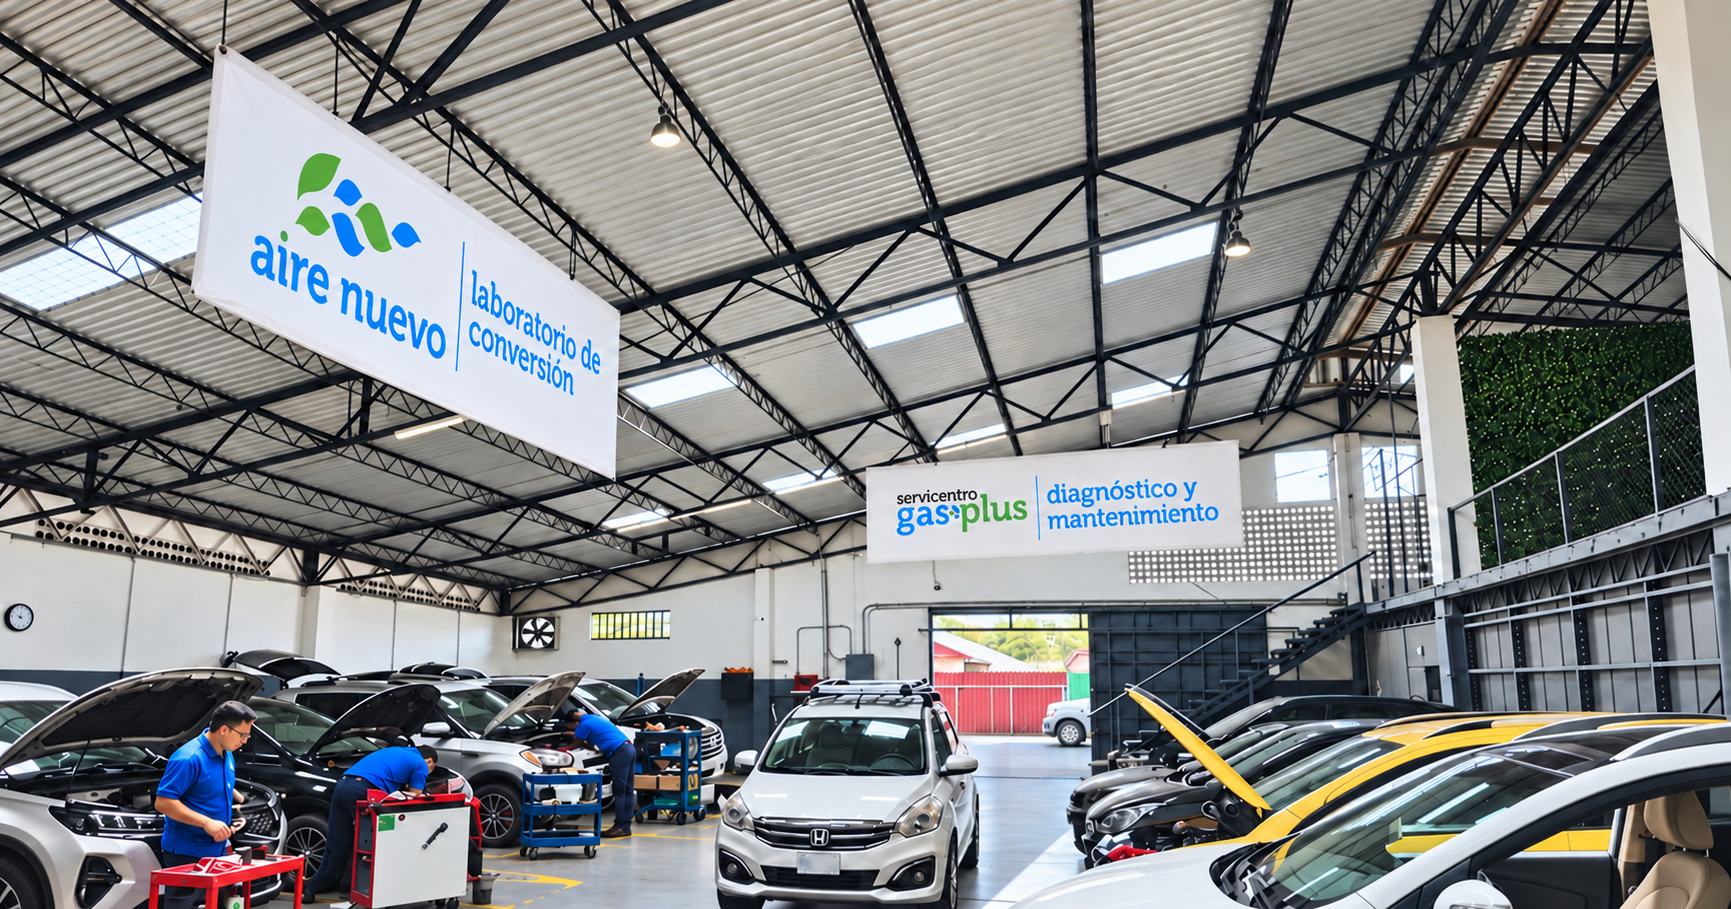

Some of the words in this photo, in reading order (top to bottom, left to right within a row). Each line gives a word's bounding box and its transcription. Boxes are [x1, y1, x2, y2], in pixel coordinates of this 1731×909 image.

[249, 230, 330, 305] aire
[340, 276, 447, 360] nuevo
[471, 269, 577, 361] laboratorio
[580, 338, 601, 376] de
[468, 320, 575, 397] conversión
[896, 488, 978, 505] servicentro
[1046, 479, 1178, 509] diagnóstico
[1182, 480, 1198, 503] y
[1046, 502, 1220, 531] mantenimiento
